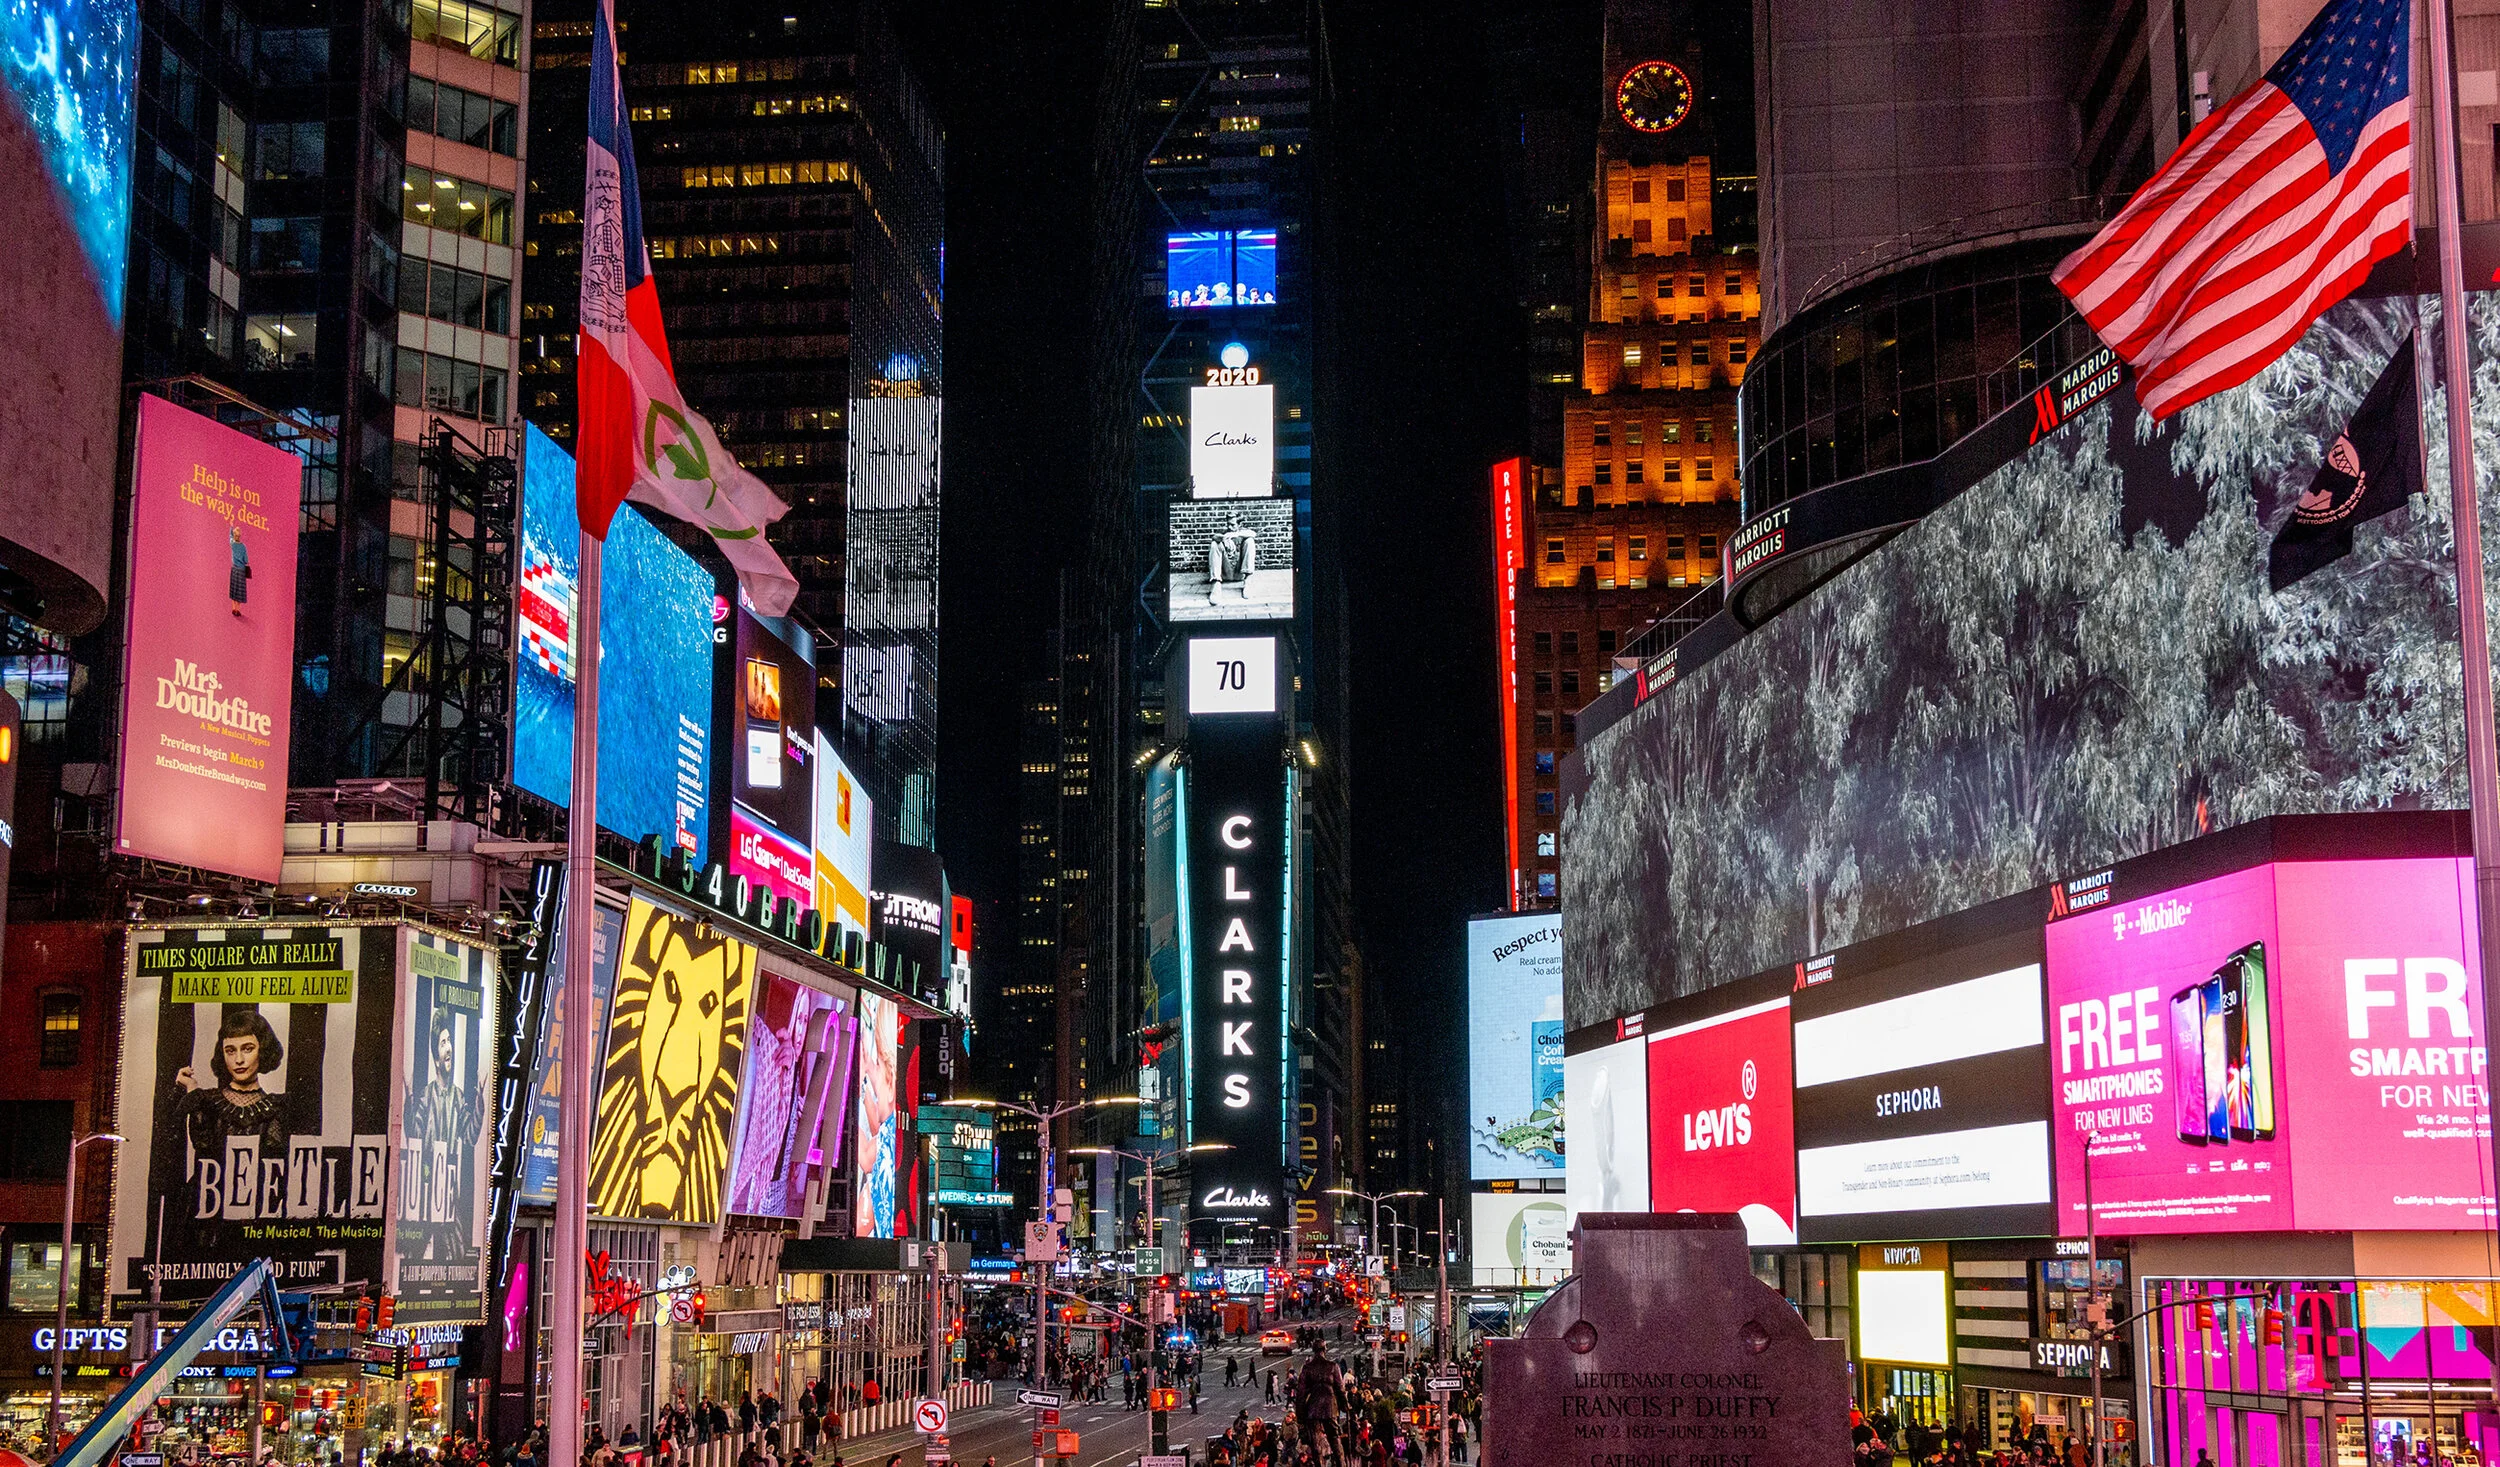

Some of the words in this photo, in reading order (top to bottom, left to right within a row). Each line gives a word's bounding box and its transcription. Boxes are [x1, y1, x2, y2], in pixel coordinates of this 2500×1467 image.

[1206, 367, 1259, 387] 2020
[2062, 367, 2120, 416] MARQUIS
[1204, 432, 1258, 447] Clarks
[193, 463, 228, 497] Help
[230, 478, 241, 499] is
[243, 489, 261, 507] on
[180, 482, 204, 506] the
[206, 494, 235, 522] way,
[237, 504, 271, 531] dear.
[1502, 471, 1513, 540] RACE
[1734, 507, 1792, 553] MARRIOTT
[1735, 533, 1783, 575] MARQUIS
[1506, 550, 1515, 601] FOR
[1648, 647, 1679, 677] MARRIOTT
[173, 657, 223, 694] Mrs.
[1216, 660, 1246, 691] 70
[1648, 665, 1676, 693] MARQUIS
[156, 676, 272, 737] Doubtfire
[160, 733, 201, 755] Previews
[203, 743, 228, 762] begin
[229, 751, 258, 770] March
[258, 758, 265, 770] 9
[155, 754, 267, 792] MrsDoubtfireBroadway.com
[740, 833, 752, 860] LG
[359, 884, 412, 896] LAMAR
[2069, 870, 2114, 894] MARRIOTT
[2070, 888, 2109, 910] MARQUIS
[652, 833, 749, 917] 1540
[760, 884, 922, 997] BROADWAY
[143, 948, 186, 969] TIMES
[190, 945, 245, 969] SQUARE
[250, 944, 279, 966] CAN
[282, 942, 338, 964] REALLY
[1492, 927, 1549, 963] Respect
[1220, 815, 1254, 1108] CLARKS
[1519, 957, 1536, 967] Real
[1537, 956, 1562, 965] cream
[1533, 968, 1544, 976] No
[1807, 954, 1836, 972] MARRIOTT
[178, 976, 220, 997] MAKE
[226, 976, 254, 997] YOU
[260, 976, 295, 997] FEEL
[301, 976, 348, 996] ALIVE!
[1807, 968, 1833, 985] MARQUIS
[2059, 985, 2163, 1074] FREE
[938, 1023, 949, 1076] 1500
[2063, 1067, 2164, 1105] SMARTPHONES
[2380, 1085, 2432, 1108] FOR
[1876, 1085, 1942, 1117] SEPHORA
[2075, 1107, 2096, 1131] FOR
[2097, 1106, 2121, 1129] NEW
[2122, 1103, 2154, 1127] LINES
[2416, 1114, 2434, 1125] Via
[2436, 1114, 2449, 1125] 24
[2451, 1116, 2472, 1125] mo.
[2403, 1127, 2473, 1139] well-qualified
[1878, 1163, 1889, 1171] more
[1890, 1159, 1903, 1170] about
[1912, 1156, 1944, 1168] commitment
[1945, 1156, 1951, 1165] to
[1951, 1154, 1960, 1164] the
[195, 1142, 384, 1220] BEETLE
[1842, 1181, 1868, 1193] Transgender
[1869, 1180, 1877, 1190] and
[1878, 1177, 1903, 1189] Non-Binary
[1904, 1176, 1932, 1187] community
[1933, 1176, 1938, 1185] at
[1939, 1169, 1991, 1186] Sephora.com/belong
[2393, 1195, 2434, 1206] Qualifying
[2470, 1197, 2479, 1205] or
[243, 1226, 263, 1239] The
[316, 1225, 338, 1238] The
[1305, 1231, 1329, 1242] hulu
[1532, 1240, 1566, 1249] Chobani
[1541, 1248, 1557, 1257] Oat
[971, 1258, 979, 1268] in
[1391, 1315, 1404, 1324] 25
[416, 1324, 464, 1345] LUGGAGE
[731, 1333, 760, 1355] FOREVER
[759, 1331, 770, 1352] 21
[77, 1366, 110, 1377] Nikon
[224, 1367, 257, 1377] BOWER
[428, 1358, 446, 1368] SONY
[1574, 1372, 1676, 1390] LIEUTENANT
[1680, 1372, 1764, 1390] COLONEL
[1023, 1393, 1035, 1402] ONE
[1041, 1396, 1056, 1404] WAY
[1561, 1395, 1663, 1419] FRANCIS
[1695, 1395, 1782, 1419] DUFFY
[347, 1398, 356, 1425] ATM
[1574, 1425, 1605, 1440] MAY
[1610, 1425, 1622, 1440] 2
[126, 1457, 138, 1465] ONE
[1590, 1453, 1679, 1467] CATHOLIC
[1688, 1453, 1754, 1467] PRIEST
